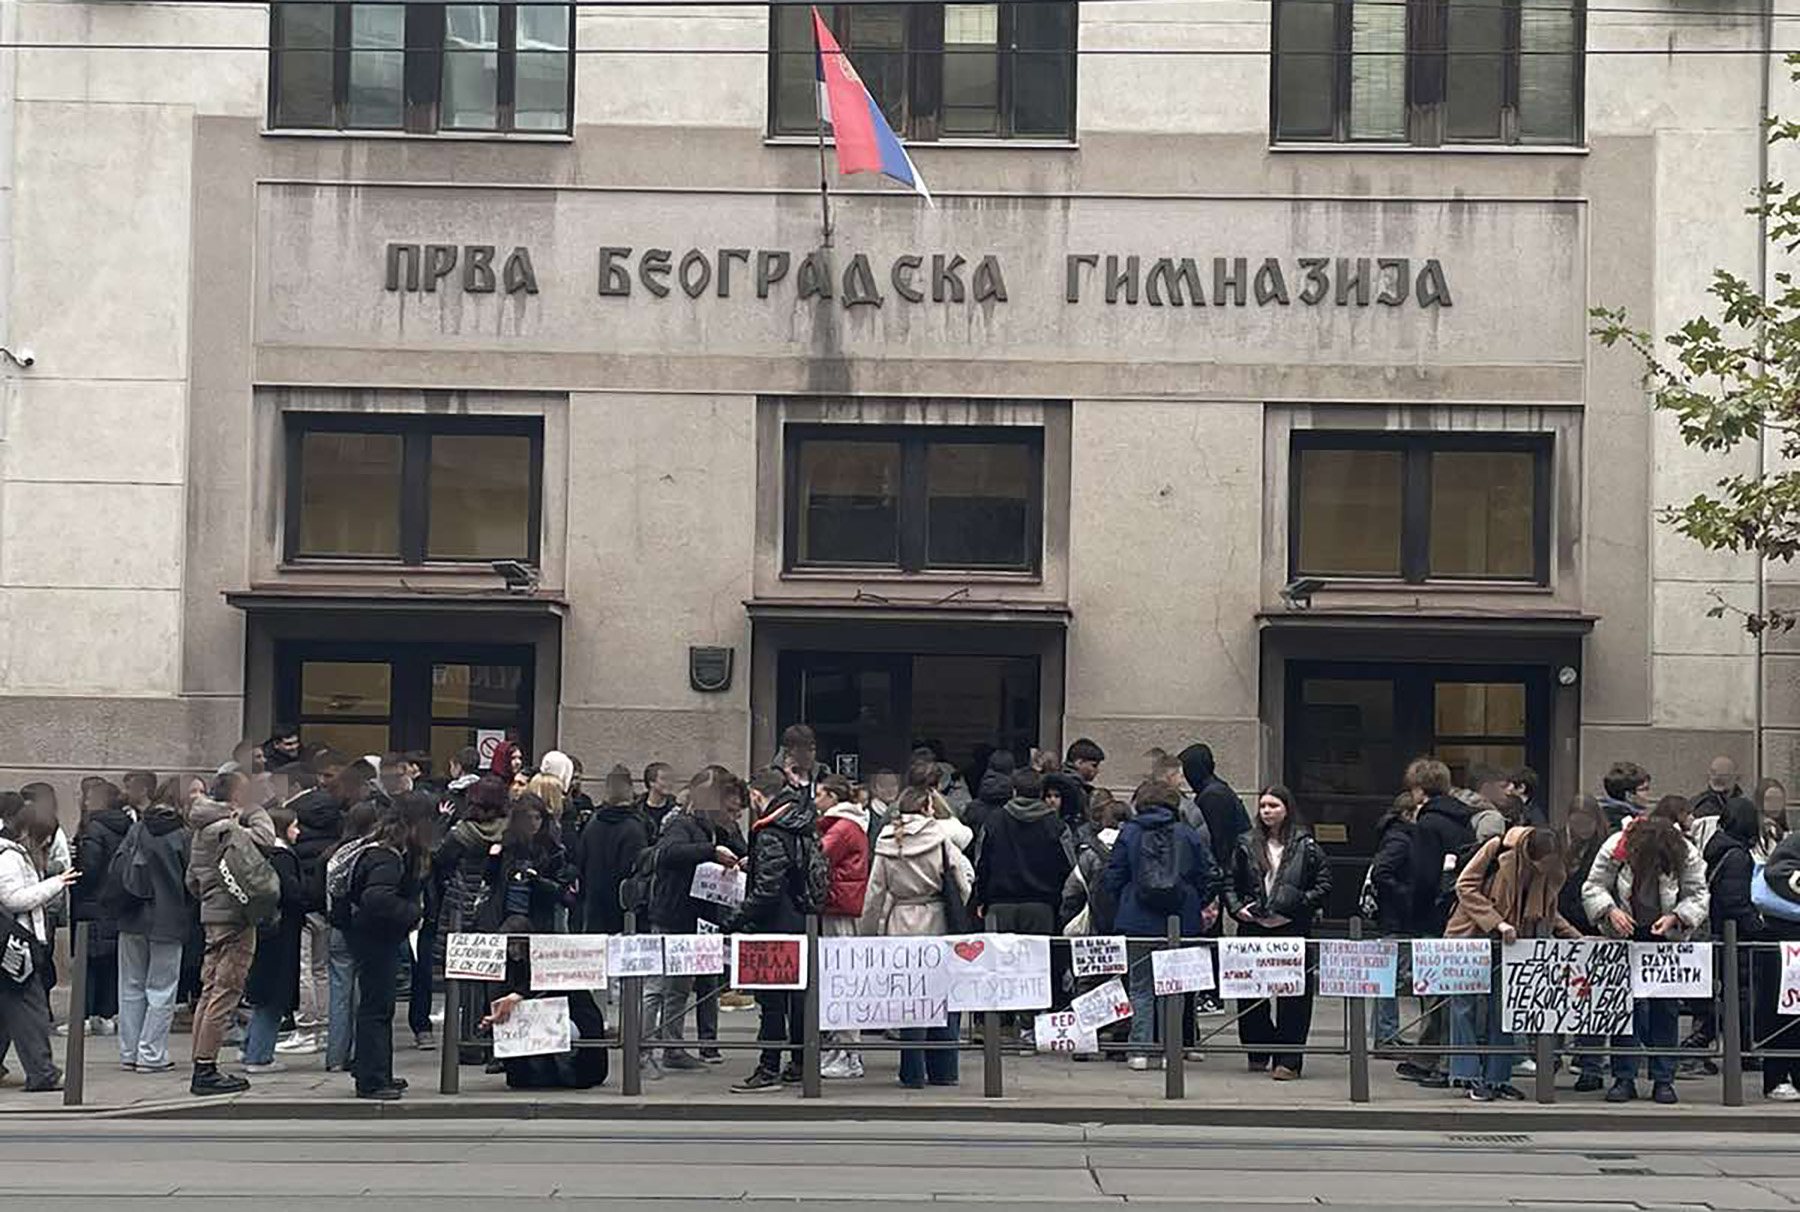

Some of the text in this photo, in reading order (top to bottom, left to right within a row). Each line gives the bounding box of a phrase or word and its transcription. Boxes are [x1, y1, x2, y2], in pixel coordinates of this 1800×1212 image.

[386, 243, 1453, 308] ПРВА БЕОГРАДСКА ГИМНАЗИЈА
[824, 944, 942, 971] И МИ СМО
[1001, 940, 1033, 968] ЗА
[1267, 942, 1290, 953] СМО
[1526, 940, 1630, 965] ДА ЈЕ МОЈА
[1507, 961, 1571, 987] ТЕРАСА
[1583, 963, 1632, 988] УБИЛА
[1641, 967, 1702, 984] СТУДЕНТИ
[826, 996, 948, 1025] СТУДЕНТИ
[1506, 985, 1569, 1010] НЕКОГА
[1596, 987, 1632, 1013] БИХ
[1050, 1013, 1076, 1028] RED
[1511, 1010, 1545, 1032] БИО
[1553, 1008, 1570, 1033] У
